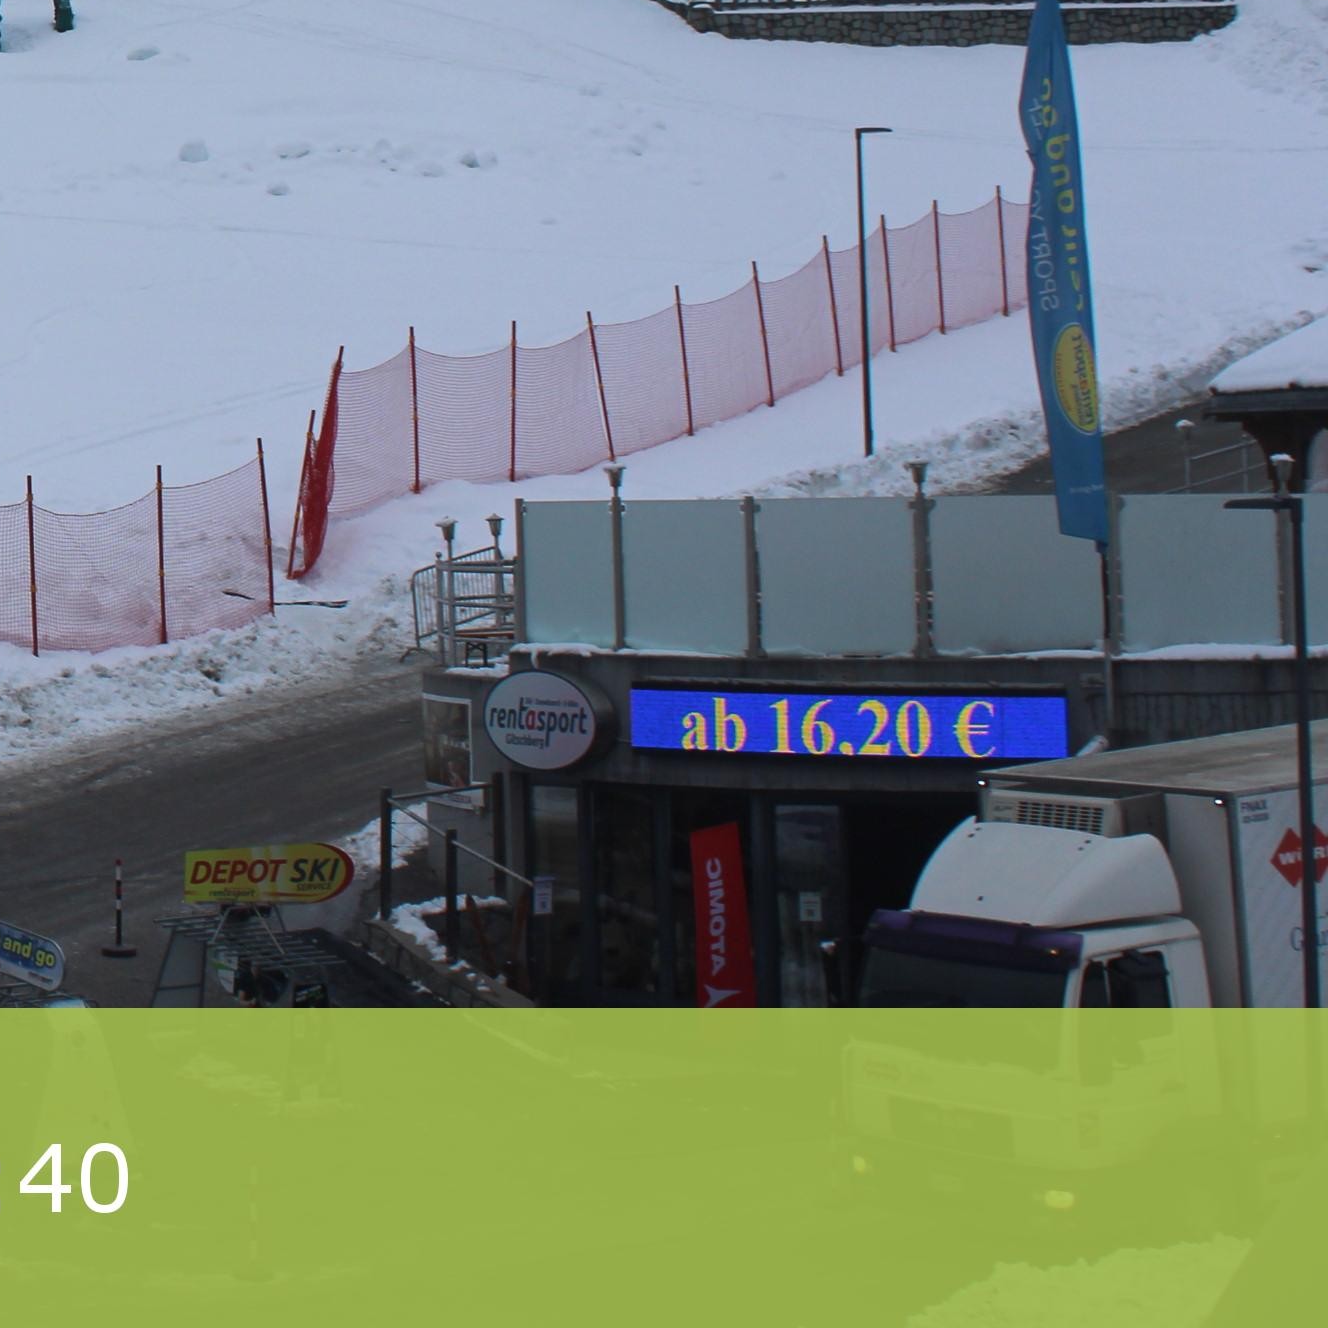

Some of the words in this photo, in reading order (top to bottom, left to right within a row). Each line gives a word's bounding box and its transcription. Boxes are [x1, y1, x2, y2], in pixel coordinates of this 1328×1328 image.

[489, 697, 587, 747] rentasport
[681, 697, 747, 753] ab
[953, 700, 995, 759] €
[189, 858, 287, 885] DEPOT
[289, 857, 341, 883] SKI
[2, 937, 33, 959] and
[34, 948, 56, 968] go
